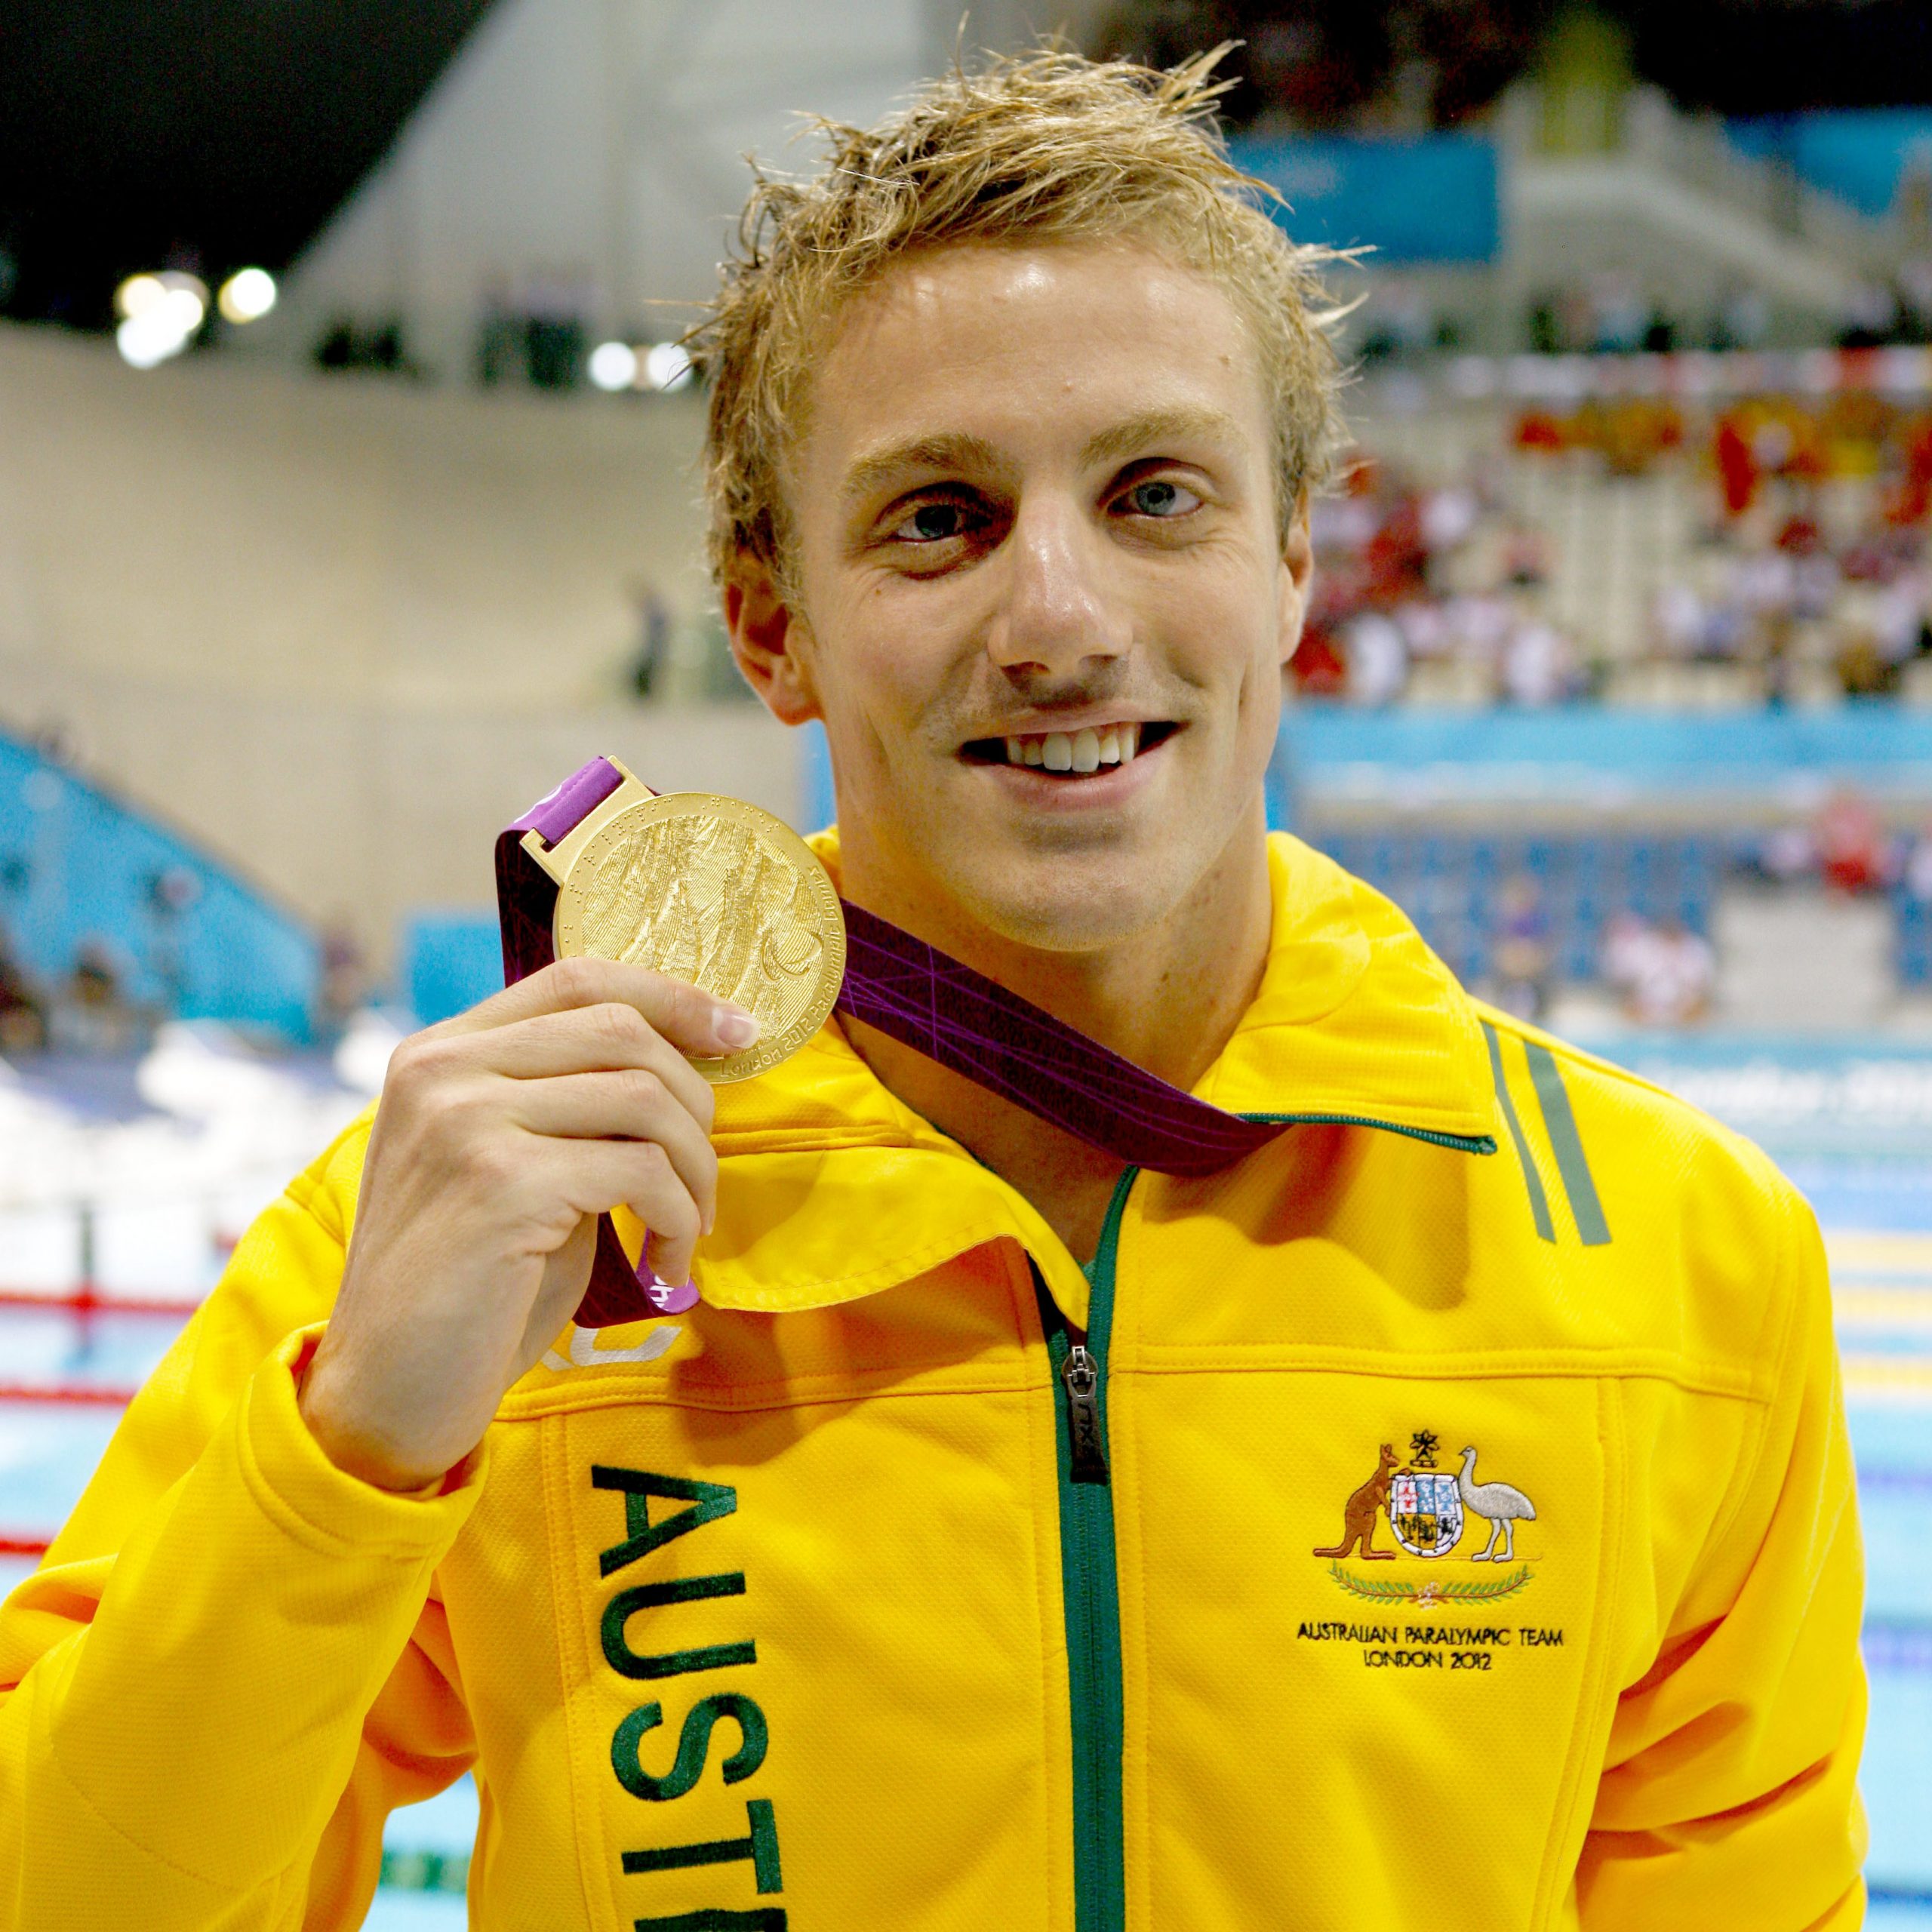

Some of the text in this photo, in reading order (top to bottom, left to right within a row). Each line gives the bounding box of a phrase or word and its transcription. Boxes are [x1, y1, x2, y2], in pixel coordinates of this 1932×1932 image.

[719, 865, 846, 1078] London 2012 Paralympic Games
[1297, 1622, 1564, 1647] AUSTRALIAN PARALYMPIC TEAM
[1363, 1648, 1493, 1672] LONDON 2012
[592, 1464, 789, 1932] AUST
